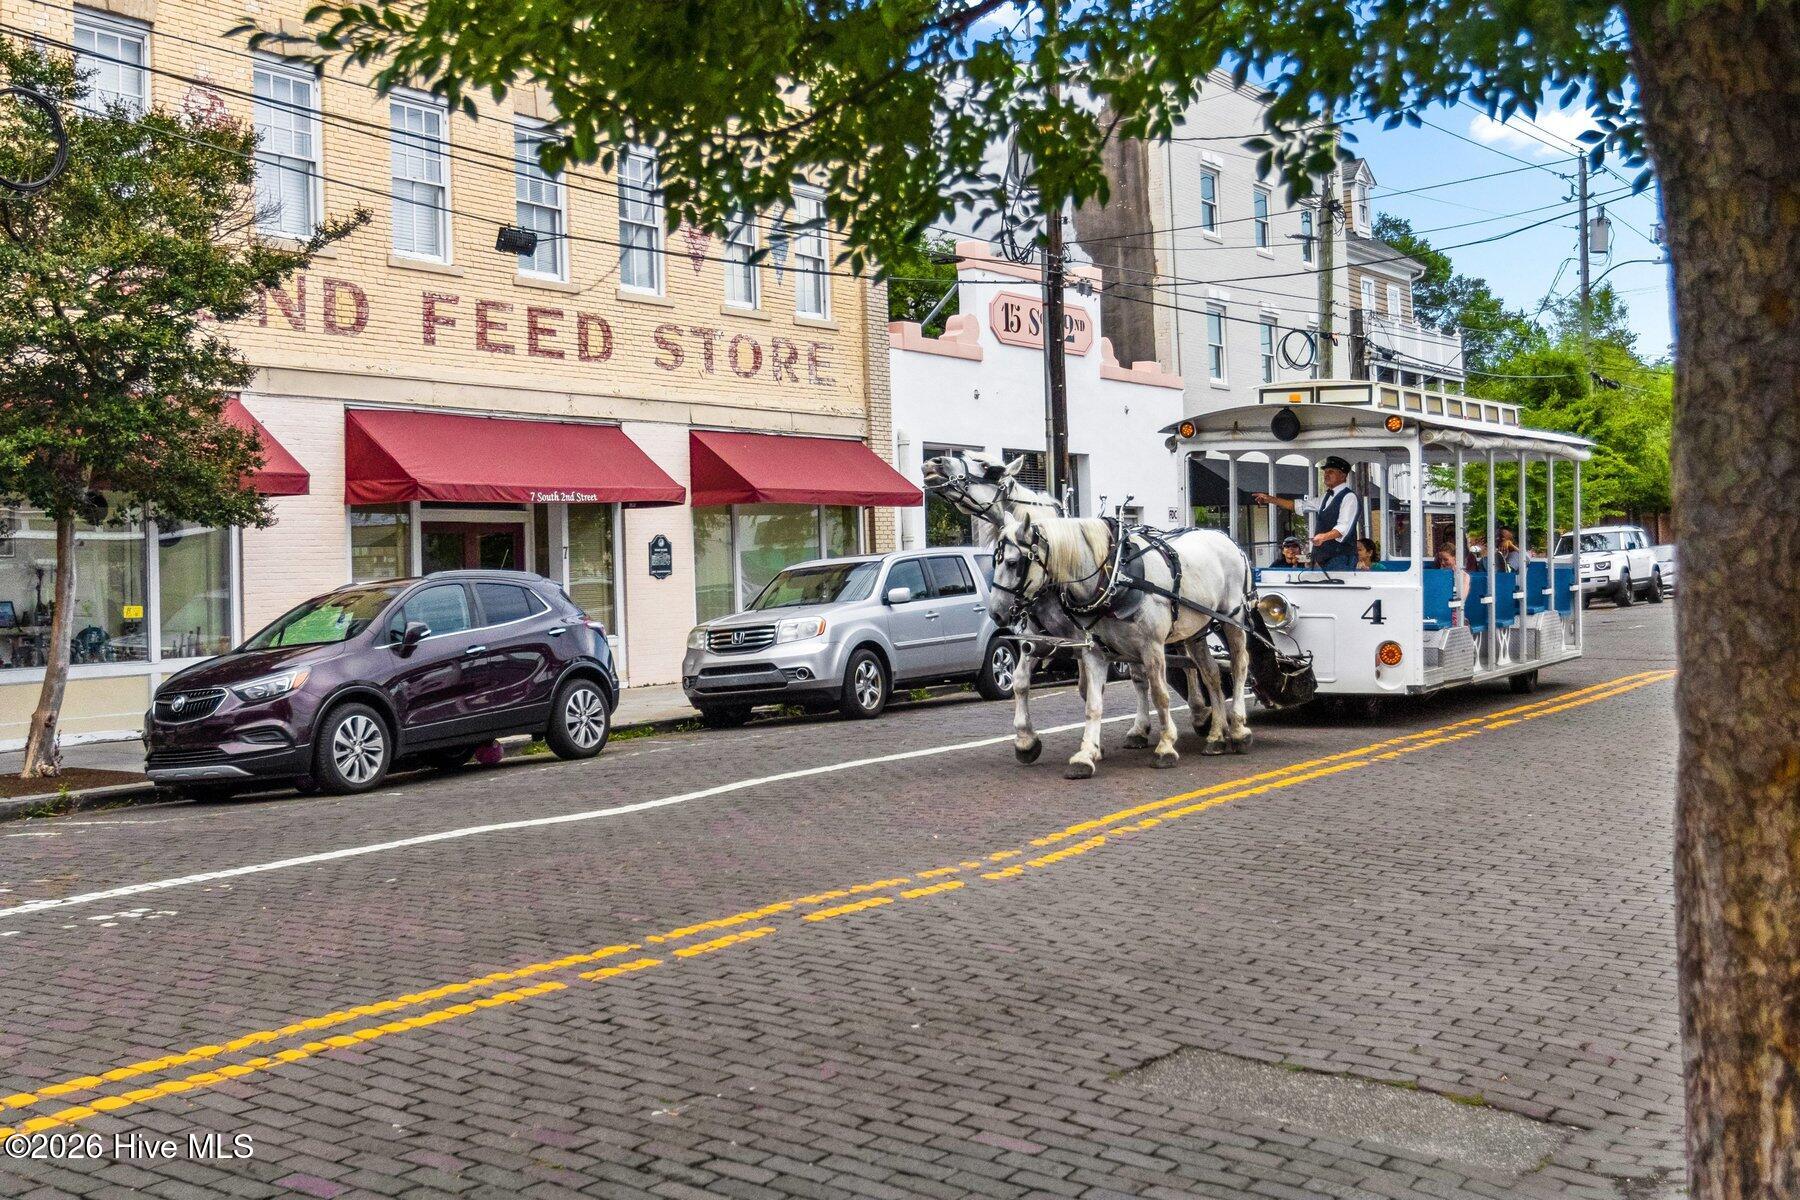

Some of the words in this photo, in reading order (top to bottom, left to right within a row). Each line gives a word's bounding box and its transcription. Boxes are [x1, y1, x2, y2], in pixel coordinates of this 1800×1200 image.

[195, 274, 369, 338] ND
[422, 291, 613, 363] FEED
[653, 323, 836, 387] STORE
[1001, 302, 1021, 334] 15
[1028, 307, 1043, 336] S
[530, 492, 535, 501] 7
[537, 491, 559, 502] South
[560, 491, 575, 502] 2nd
[576, 492, 598, 502] Street
[562, 546, 568, 560] 7
[1361, 599, 1387, 625] 4
